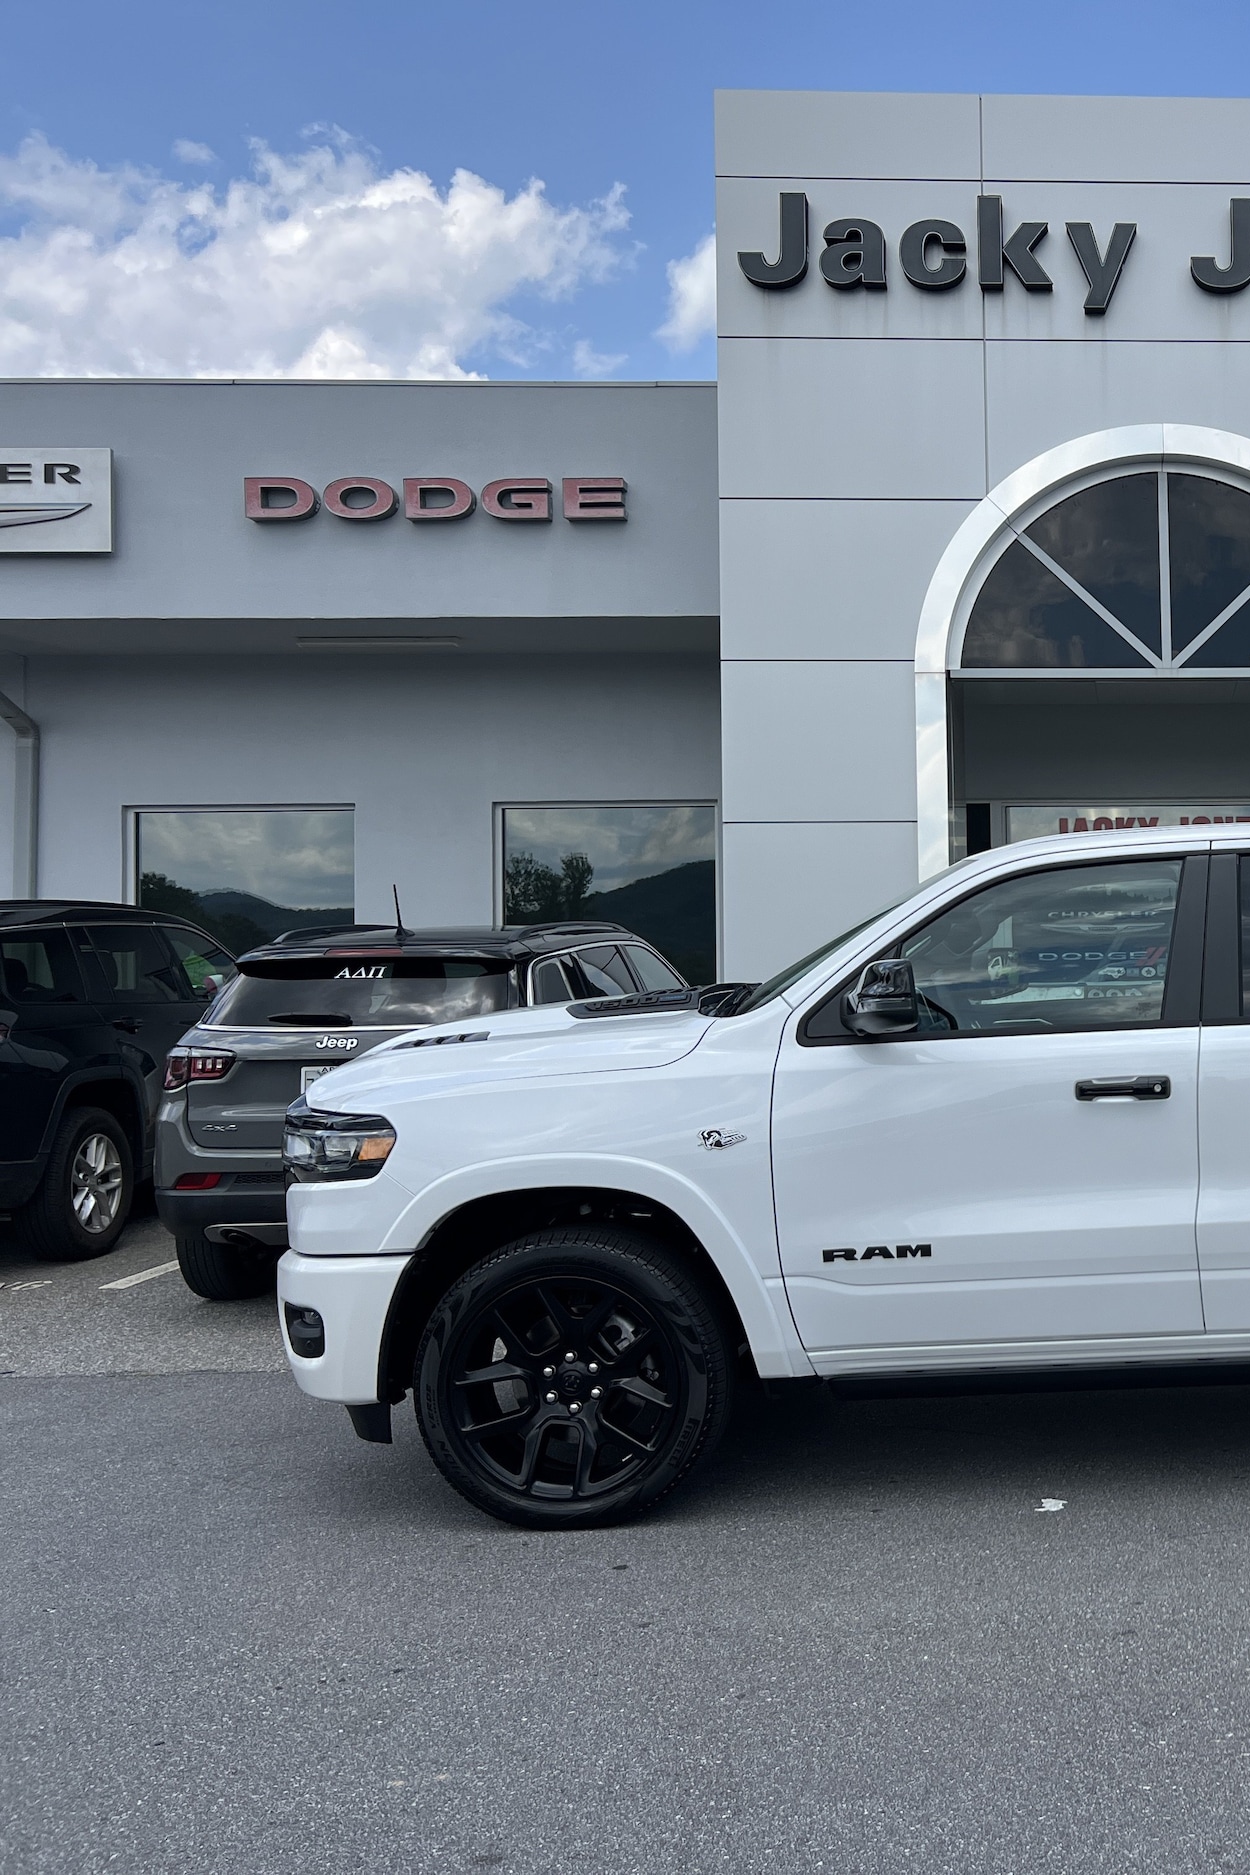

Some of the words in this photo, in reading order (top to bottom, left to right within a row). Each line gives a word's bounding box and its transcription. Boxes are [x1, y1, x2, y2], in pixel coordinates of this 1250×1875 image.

[738, 192, 1136, 315] Jacky
[243, 476, 629, 523] DODGE
[1038, 951, 1150, 961] DODGE
[315, 1035, 359, 1051] Jeep
[822, 1243, 932, 1263] RAM
